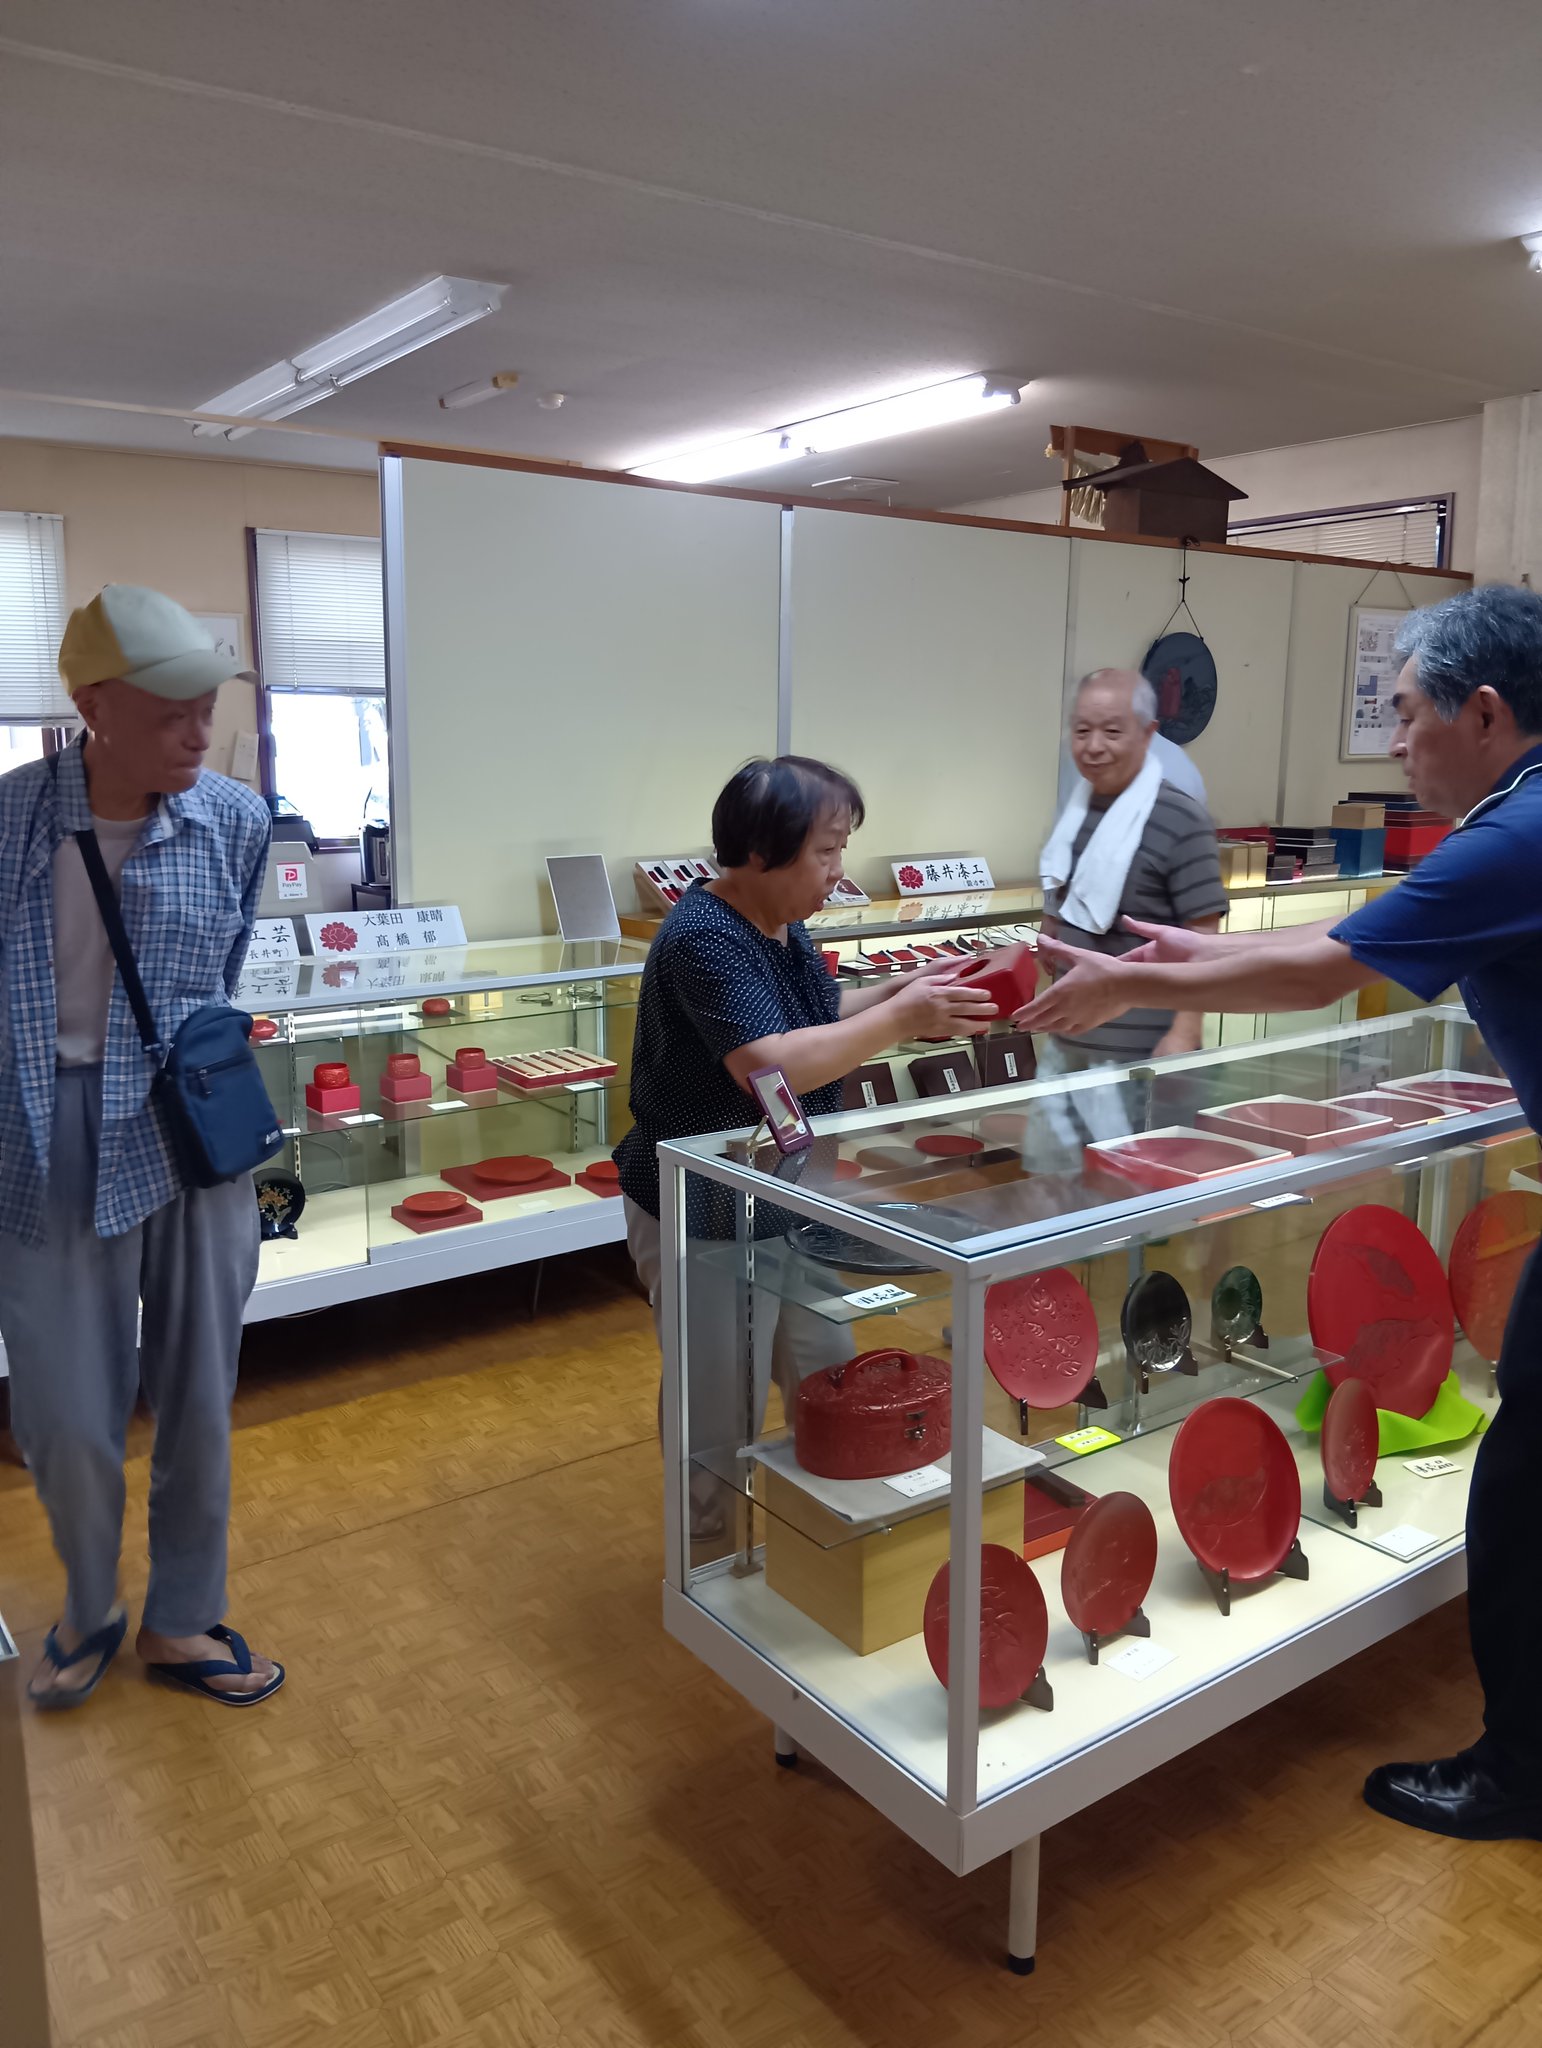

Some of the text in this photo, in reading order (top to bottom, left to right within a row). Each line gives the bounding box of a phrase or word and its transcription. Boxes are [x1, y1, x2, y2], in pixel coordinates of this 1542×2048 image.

[925, 862, 984, 882] 藤井漆工
[362, 909, 443, 927] 大葉田 康晴
[250, 925, 291, 943] 工芸
[422, 930, 437, 944] 郁
[248, 947, 290, 960] 長井町)
